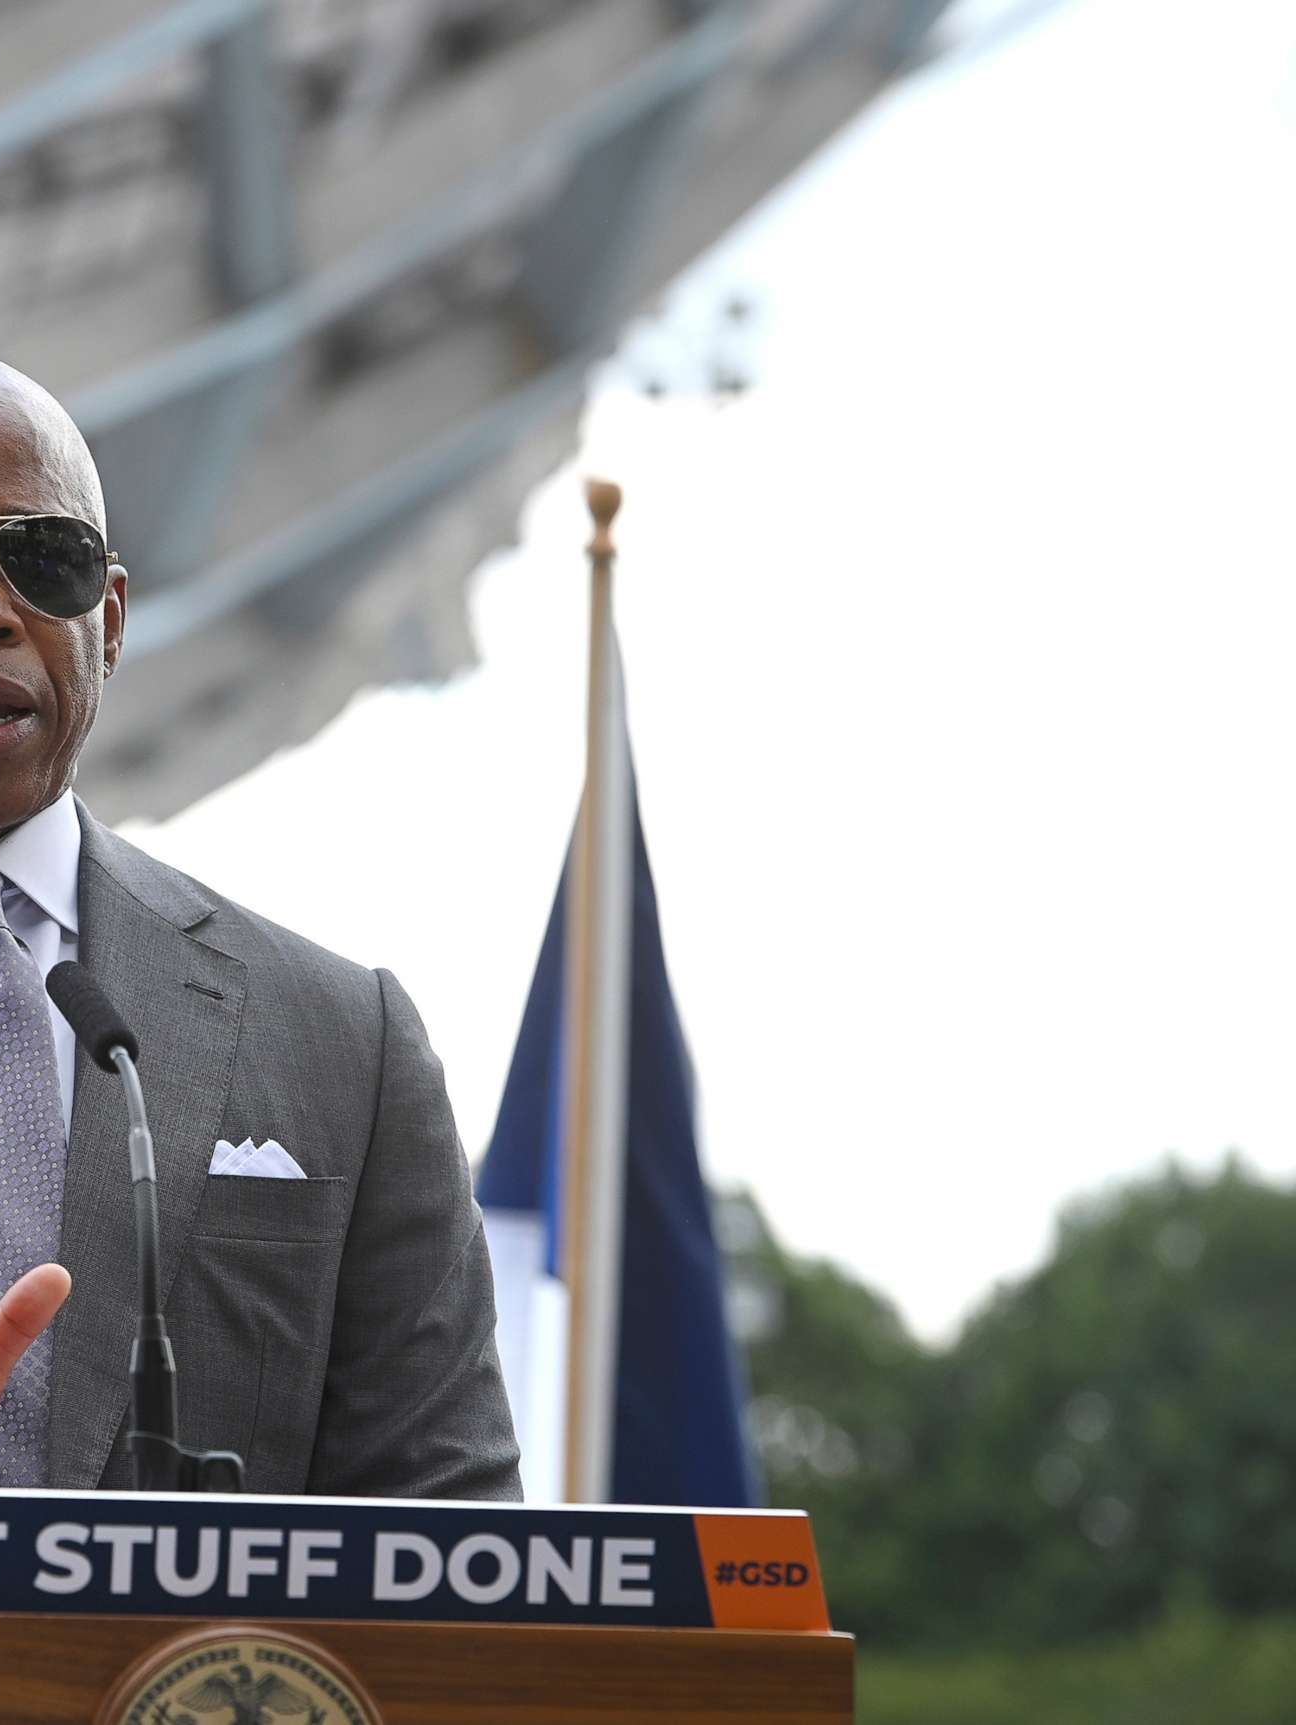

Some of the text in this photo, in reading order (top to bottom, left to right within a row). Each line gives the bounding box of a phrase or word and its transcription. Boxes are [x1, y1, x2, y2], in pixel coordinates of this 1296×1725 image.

[35, 1522, 343, 1599] STUFF
[372, 1532, 656, 1607] DONE
[714, 1560, 810, 1588] #GSD
